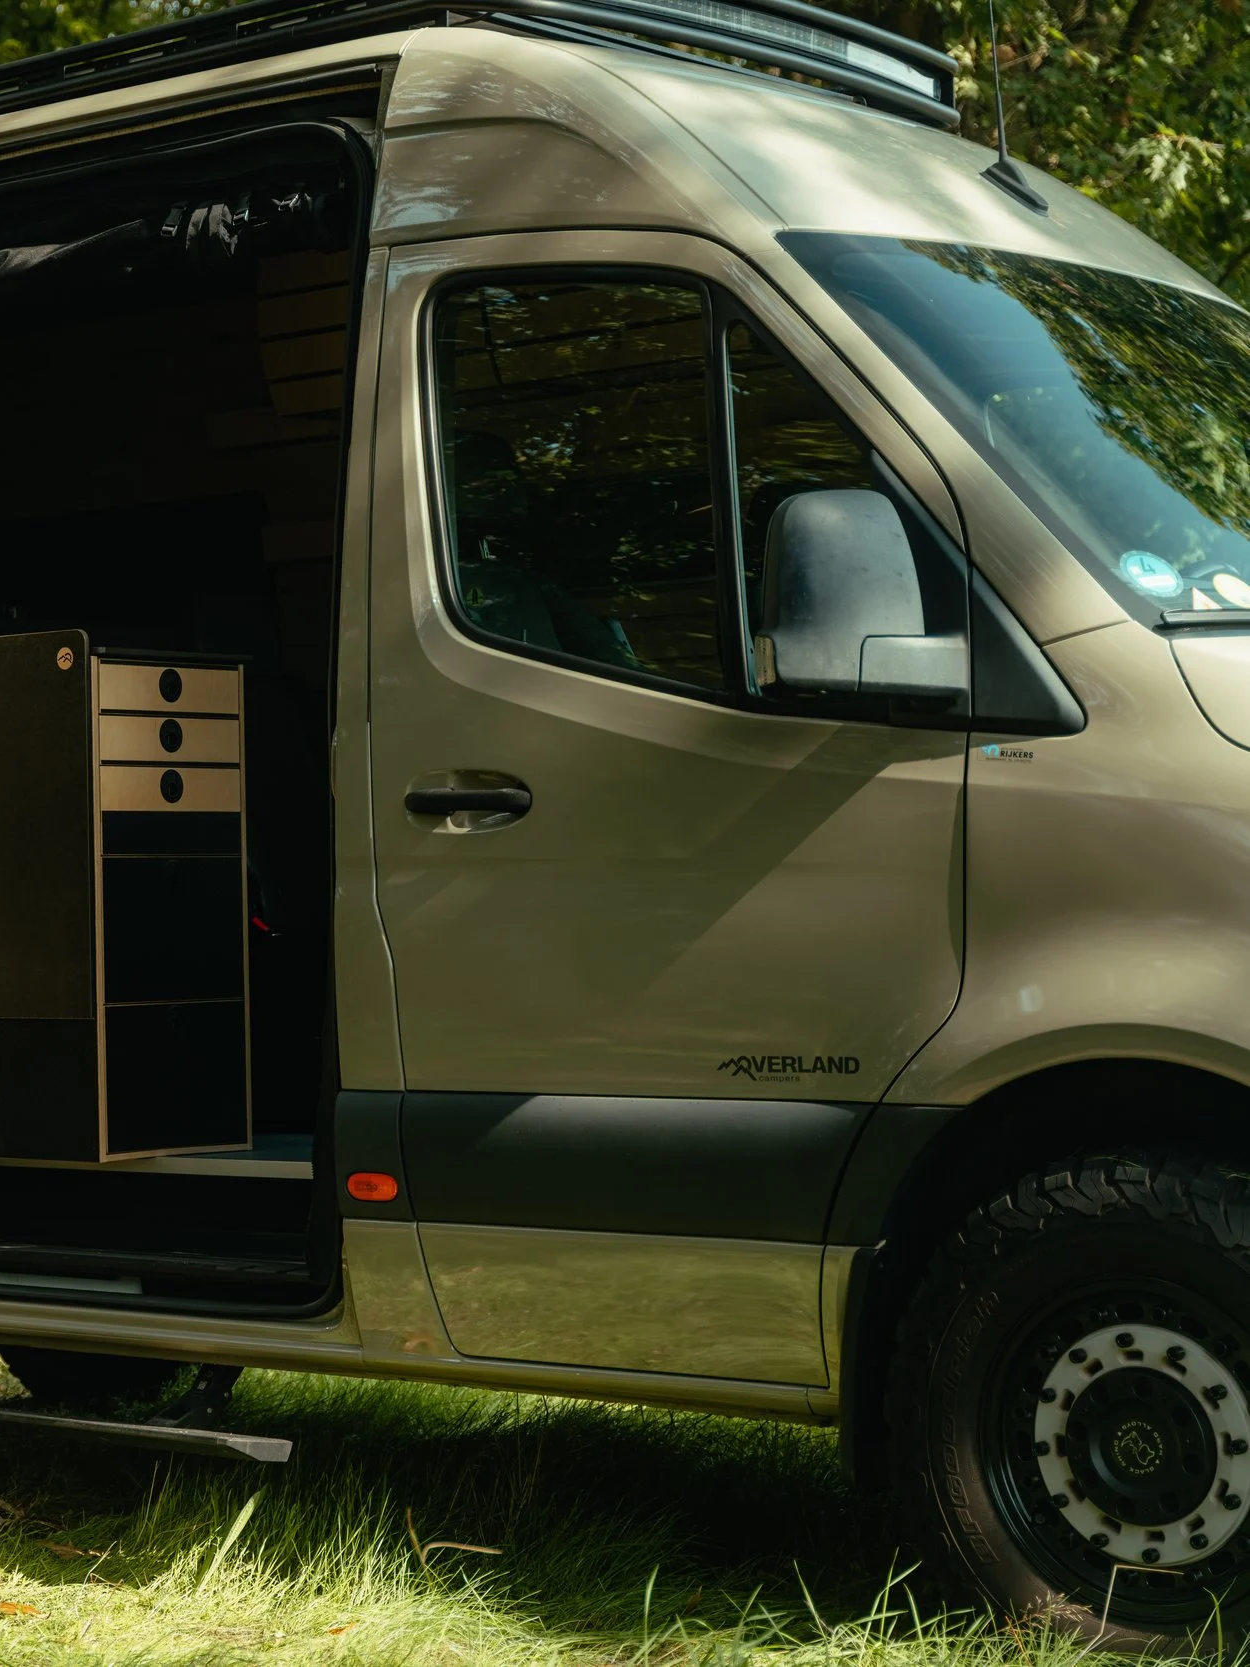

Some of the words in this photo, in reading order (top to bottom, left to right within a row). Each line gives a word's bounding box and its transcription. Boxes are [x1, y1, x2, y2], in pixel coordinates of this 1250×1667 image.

[1000, 750, 1034, 759] RIJKERS
[736, 1055, 860, 1075] OVERLAND
[758, 1074, 801, 1082] campers
